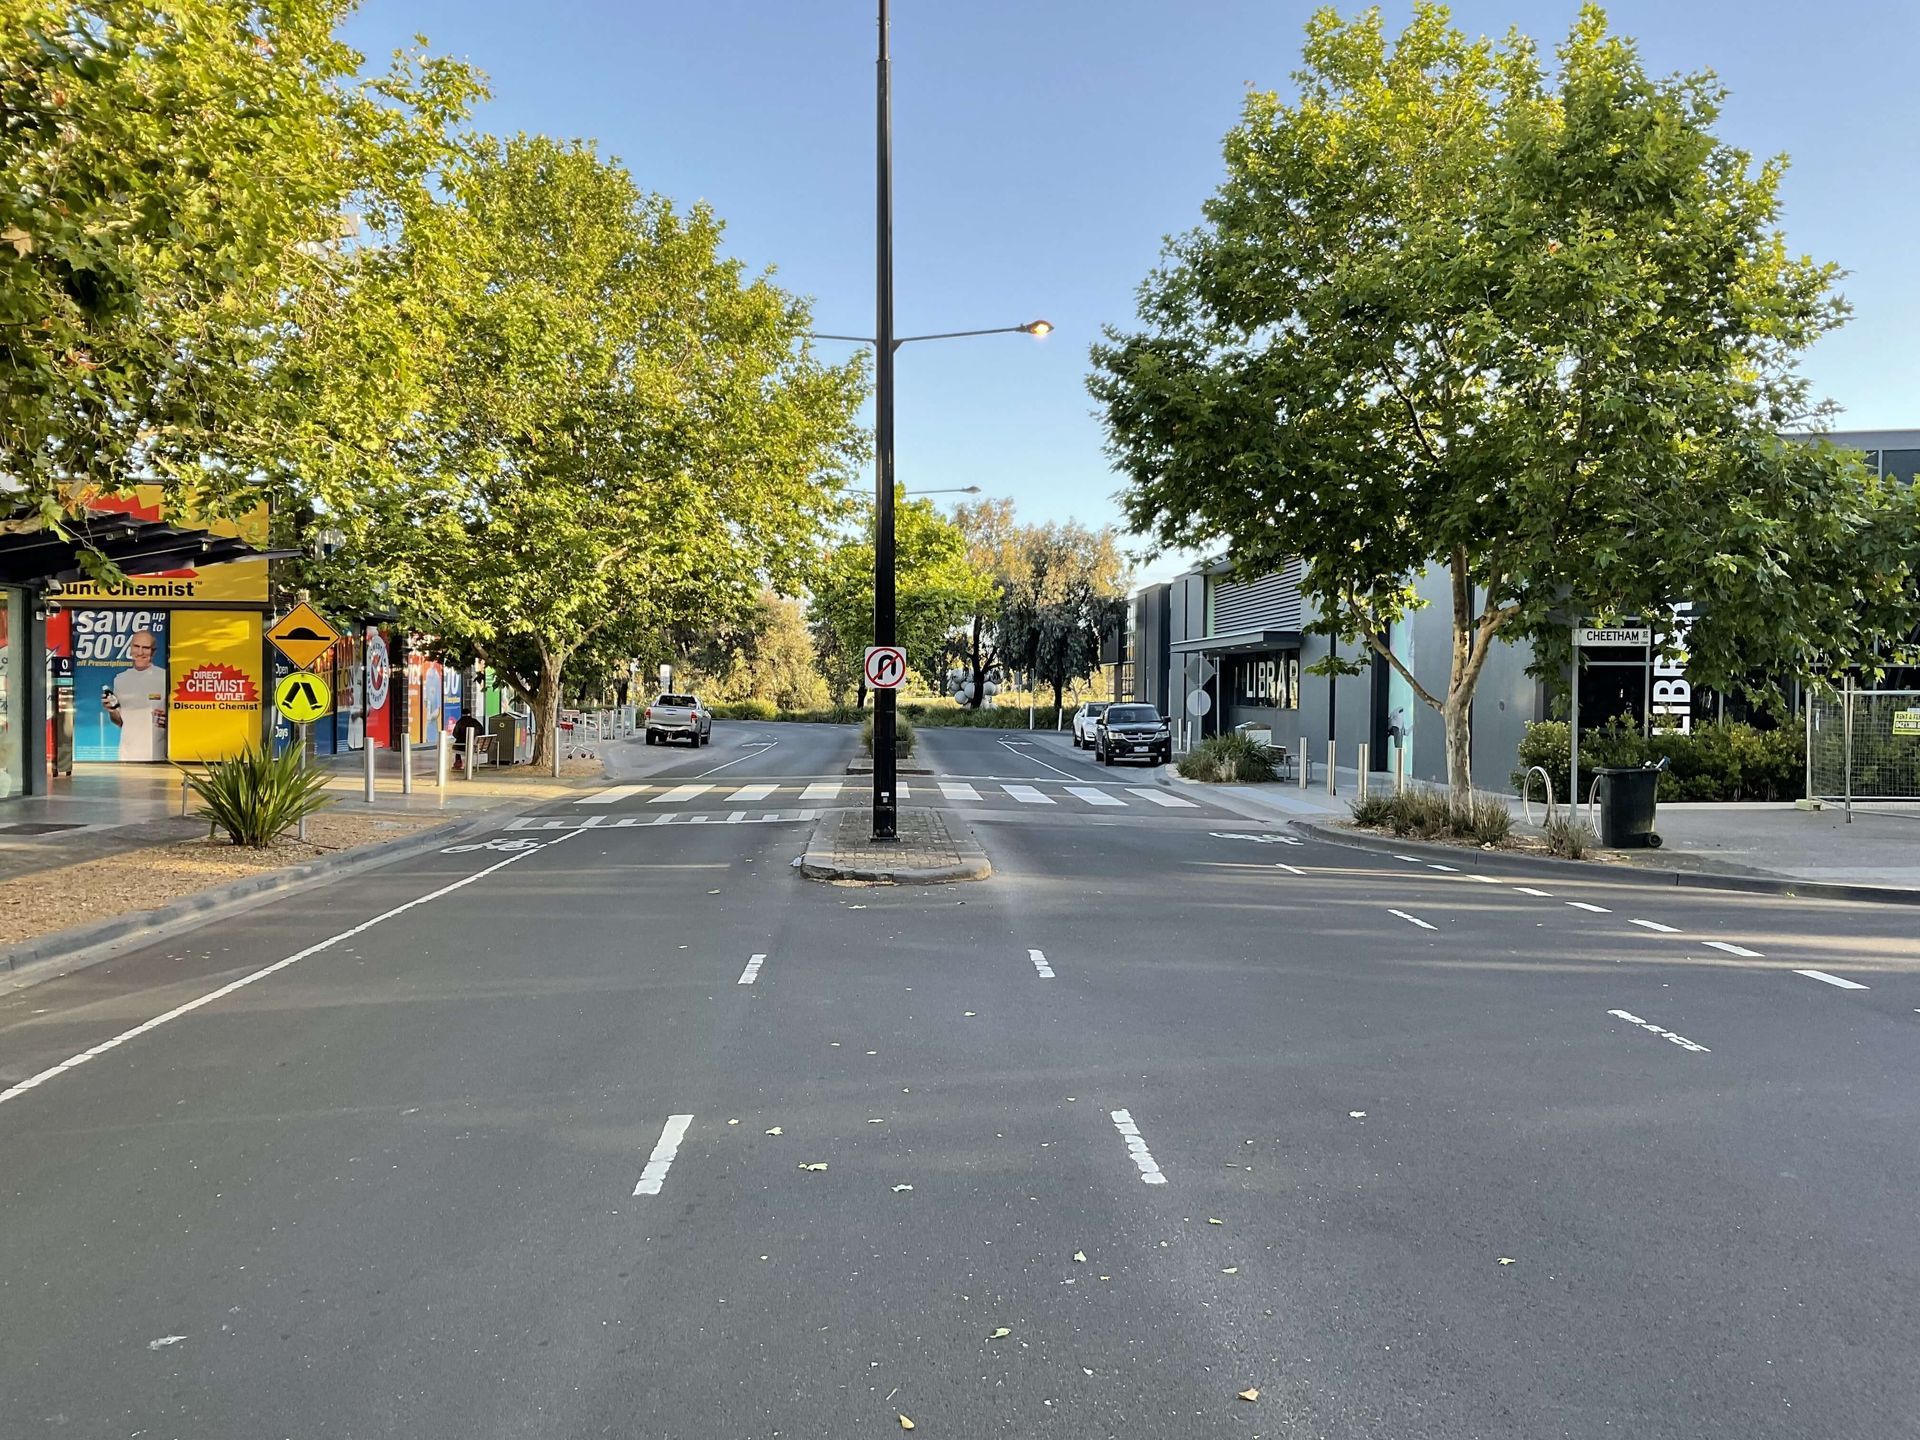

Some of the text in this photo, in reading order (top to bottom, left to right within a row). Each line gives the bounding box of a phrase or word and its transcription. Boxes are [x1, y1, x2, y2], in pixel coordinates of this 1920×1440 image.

[107, 581, 194, 596] Chemist
[76, 610, 151, 633] save
[152, 612, 166, 621] up
[152, 622, 163, 632] to
[1586, 630, 1639, 641] CHEETHAM
[75, 634, 135, 660] 50%
[193, 671, 222, 680] DIRECT
[186, 679, 246, 693] CHEMIST
[214, 692, 246, 701] OUTLET
[173, 702, 258, 710] Discount Chemist
